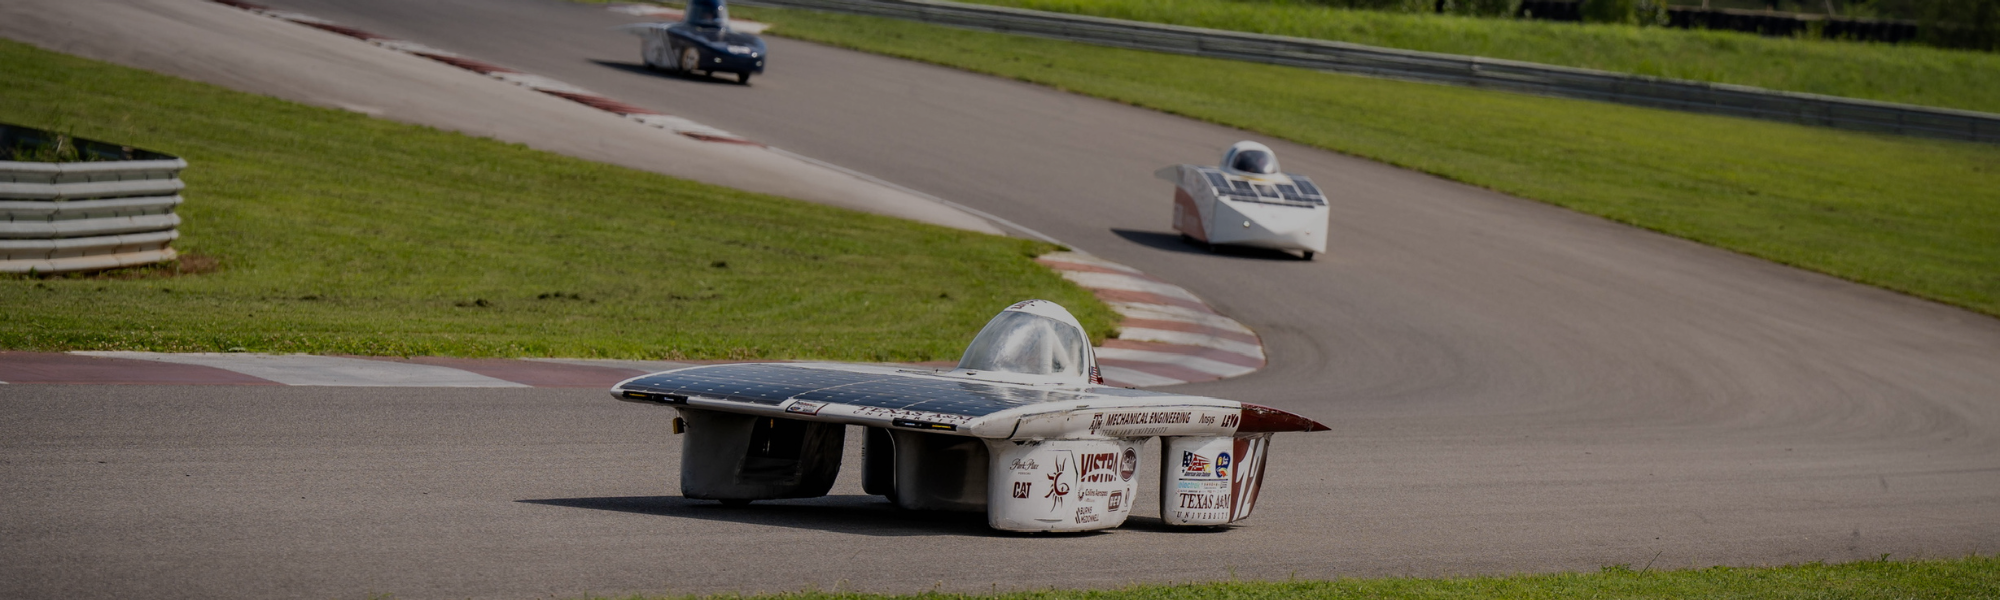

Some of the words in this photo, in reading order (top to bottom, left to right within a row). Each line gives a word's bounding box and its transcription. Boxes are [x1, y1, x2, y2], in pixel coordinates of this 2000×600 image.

[1106, 412, 1148, 426] MECHANICAL
[1149, 412, 1191, 424] ENGINEERING
[1081, 452, 1118, 483] VISTRA
[1013, 481, 1032, 499] CAT
[1179, 493, 1214, 509] TEXAS
[1214, 494, 1230, 509] A&M
[1177, 511, 1228, 520] UNIVERSITY
